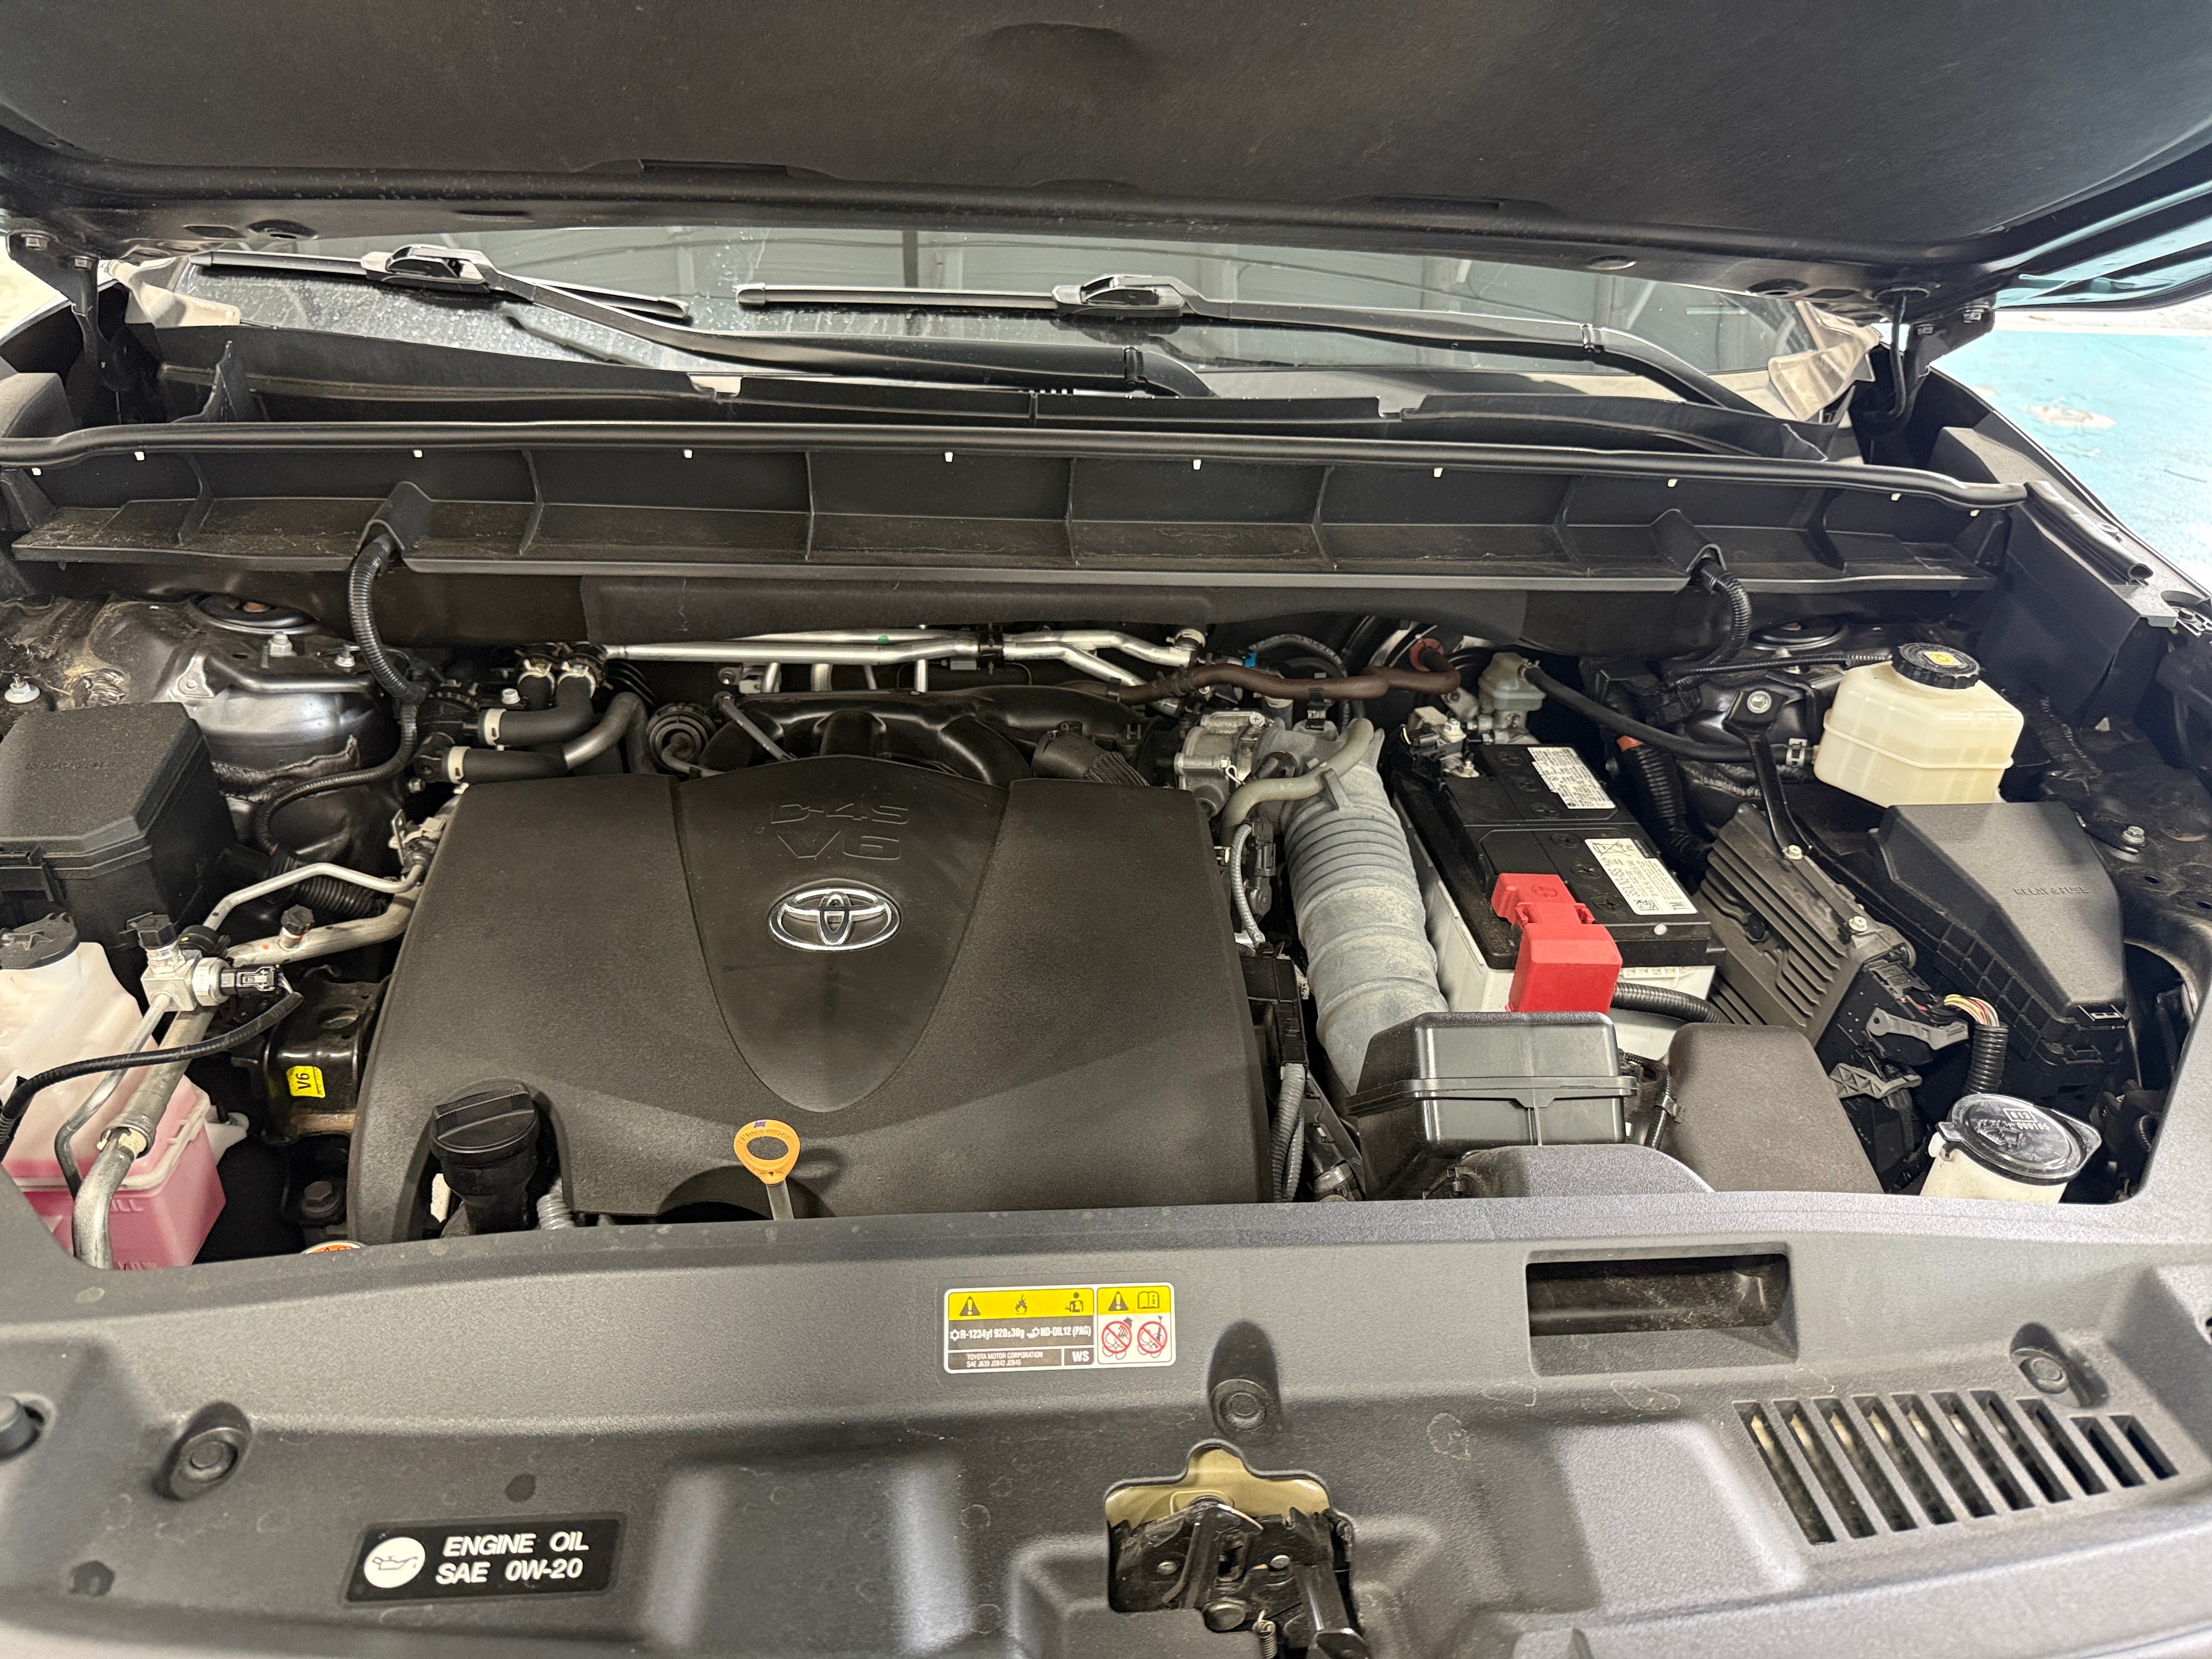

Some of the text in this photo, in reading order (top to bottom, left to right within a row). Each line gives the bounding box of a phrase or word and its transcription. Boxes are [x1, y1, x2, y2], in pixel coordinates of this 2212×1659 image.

[771, 803, 909, 824] D-4S
[775, 830, 901, 860] V6
[2058, 886, 2090, 894] FUSE
[296, 1073, 311, 1090] V6
[960, 1329, 993, 1340] R-1234yf
[994, 1328, 1025, 1339] 920±30g
[1072, 1325, 1092, 1337] (PAG)
[1071, 1351, 1090, 1362] WS
[443, 1532, 589, 1557] ENGINE OIL
[436, 1558, 583, 1584] SAE 0W-20
